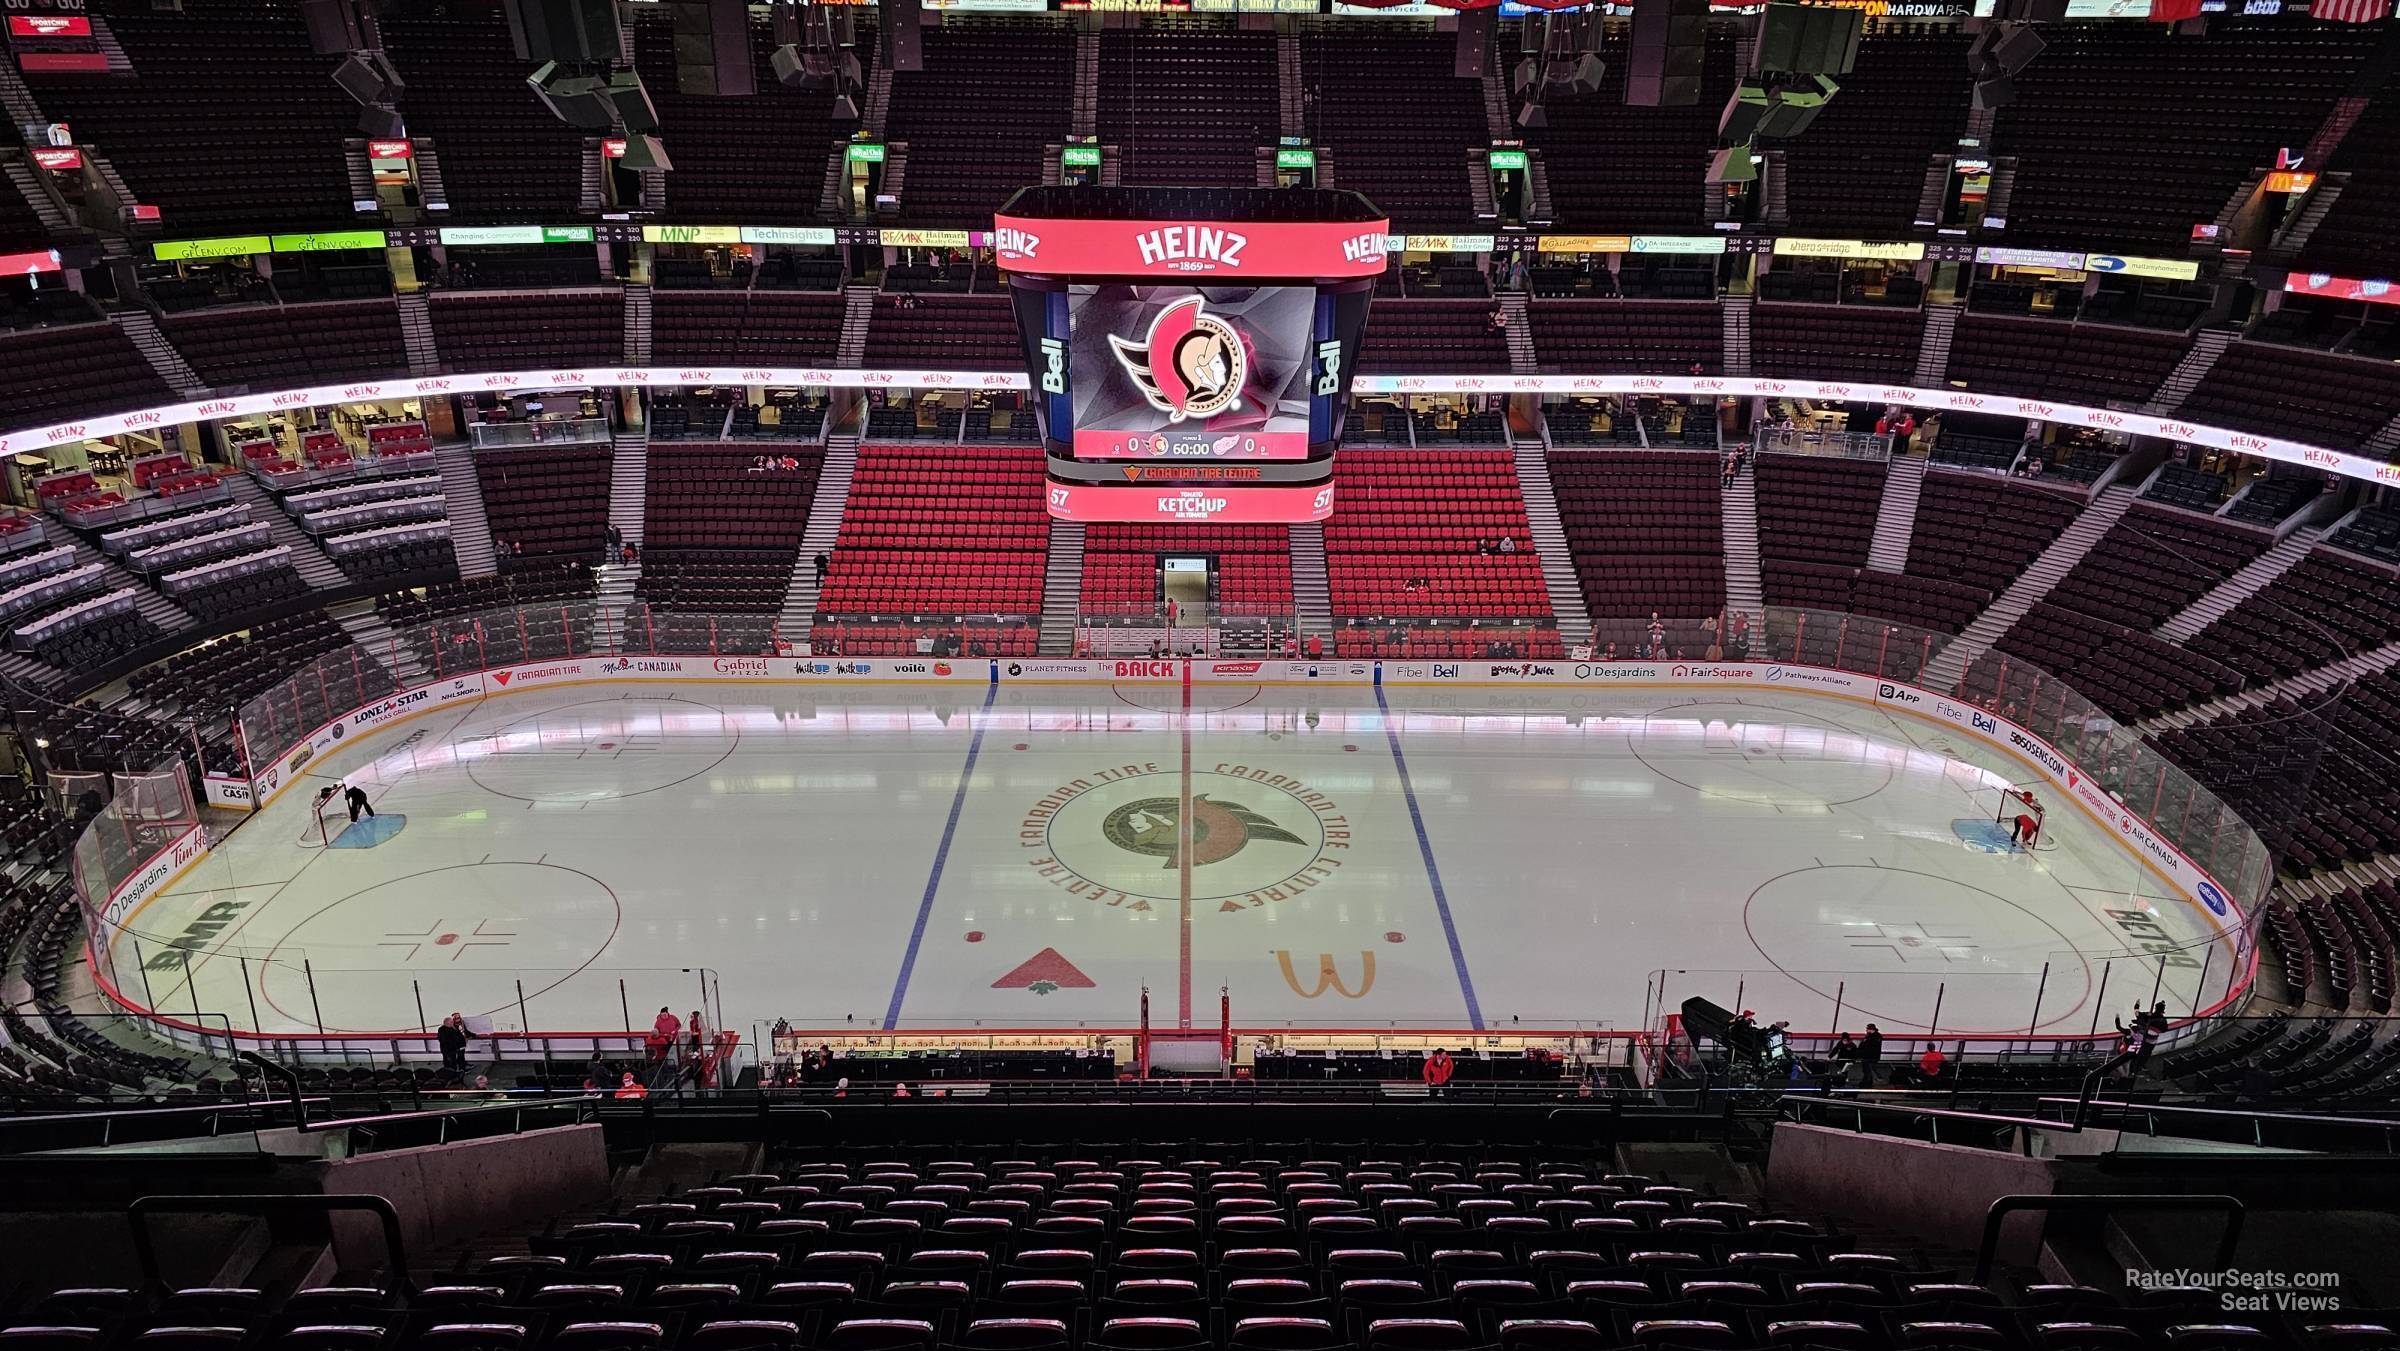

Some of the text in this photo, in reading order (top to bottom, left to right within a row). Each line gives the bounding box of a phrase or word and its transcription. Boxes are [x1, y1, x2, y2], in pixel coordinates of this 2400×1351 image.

[1887, 4, 1963, 16] HARDWARE
[450, 233, 485, 241] Changing
[660, 227, 701, 241] MNP
[752, 228, 824, 241] TechInsights
[881, 230, 967, 244] RE/MAX Hallmark
[1136, 225, 1248, 267] HEINZ
[1408, 237, 1449, 249] RE/MAX
[1179, 261, 1204, 271] 1869
[1041, 337, 1065, 395] Bell
[1317, 339, 1342, 397] Bell
[484, 375, 519, 388] HEINZ
[551, 373, 585, 384] HEINZ
[616, 371, 649, 382] HEINZ
[679, 371, 712, 382] HEINZ
[742, 370, 773, 381] HEINZ
[801, 371, 833, 382] HEINZ
[862, 372, 893, 383] HEINZ
[922, 373, 953, 384] HEINZ
[982, 375, 1013, 385] HEINZ
[415, 380, 451, 392] HEINZ
[1395, 378, 1426, 388] HEINZ
[1455, 378, 1486, 389] HEINZ
[1514, 378, 1544, 389] HEINZ
[1573, 378, 1604, 389] HEINZ
[1632, 378, 1664, 389] HEINZ
[1693, 379, 1725, 391] HEINZ
[1754, 380, 1787, 393] HEINZ
[344, 386, 381, 398] HEINZ
[1818, 384, 1850, 397] HEINZ
[1882, 389, 1917, 402] HEINZ
[272, 393, 309, 407] HEINZ
[1949, 395, 1985, 409] HEINZ
[197, 401, 237, 416] HEINZ
[2018, 402, 2054, 417] HEINZ
[123, 412, 162, 428] HEINZ
[2087, 412, 2124, 428] HEINZ
[47, 425, 86, 443] HEINZ
[2159, 423, 2196, 438] HEINZ
[1128, 437, 1139, 451] 0
[1172, 443, 1210, 455] 60:00
[1244, 438, 1255, 452] 0
[2230, 436, 2268, 453] HEINZ
[2304, 449, 2342, 469] HEINZ
[1144, 467, 1261, 480] CANADIAN TIRE CENTRE
[1050, 488, 1070, 507] 57
[1313, 487, 1332, 509] 57
[1156, 497, 1227, 513] KETCHUP
[637, 661, 682, 672] CANADIAN
[713, 658, 769, 673] Gabriel
[894, 662, 926, 673] voilà
[1025, 665, 1088, 673] PLANET FITNESS
[1098, 661, 1174, 677] The BRICK
[1397, 664, 1459, 678] Fibe Bell
[1490, 665, 1555, 677] Booster Juice
[517, 665, 582, 681] CANADIAN TIRE
[1594, 666, 1656, 679] Desjardins
[1691, 667, 1753, 679] FairSquare
[1784, 671, 1852, 687] Pathways Alliance
[354, 689, 429, 725] LONE STAR
[371, 706, 412, 726] TEXAS GRILL
[1936, 701, 1996, 735] Fibe Bell
[1020, 778, 1094, 849] CANADIAN
[1094, 762, 1160, 783] TIRE
[1214, 763, 1336, 812] CANADIAN
[1322, 815, 1351, 849] TIRE
[2078, 784, 2117, 823] CANADIAN TIRE
[2131, 827, 2178, 870] AIR CANADA
[119, 842, 193, 912] Desjardins Tim
